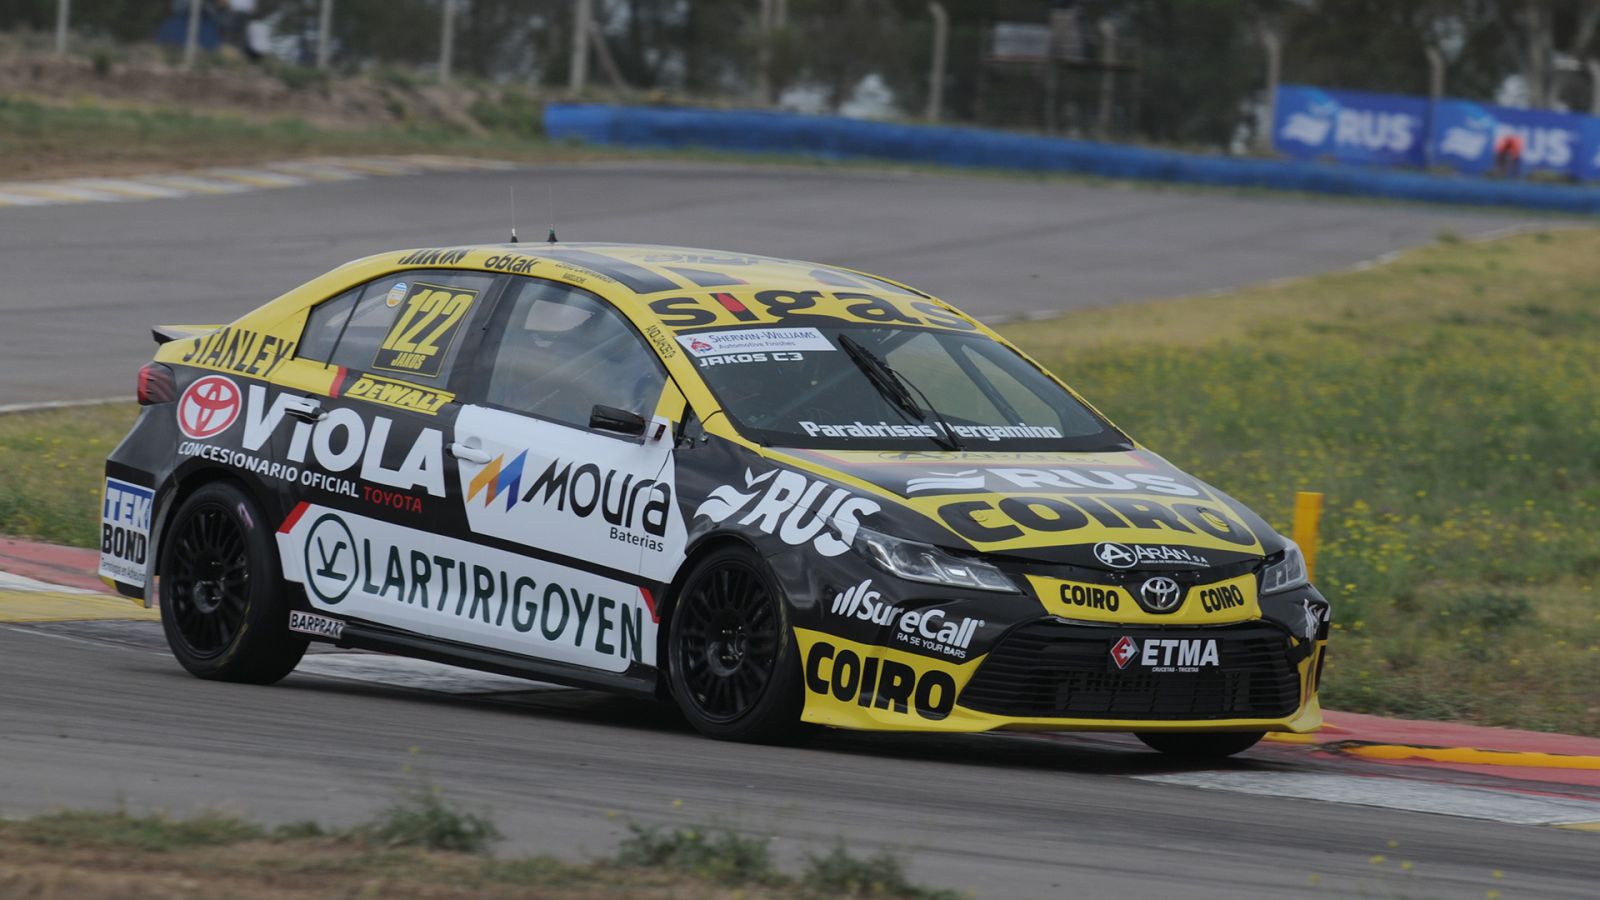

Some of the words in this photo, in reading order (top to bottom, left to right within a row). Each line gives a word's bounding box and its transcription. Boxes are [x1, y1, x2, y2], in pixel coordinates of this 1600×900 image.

[1335, 108, 1414, 152] RUS
[382, 289, 473, 356] 122
[182, 327, 294, 377] STANLEY
[391, 354, 427, 370] JAKOS
[700, 353, 768, 367] JAKOS
[773, 352, 804, 362] C3
[799, 421, 937, 438] Parabrisas
[178, 441, 298, 482] CONCESIONARIO
[301, 470, 359, 498] OFICIAL
[363, 485, 422, 513] TOYOTA
[985, 468, 1200, 497] RUS
[101, 487, 151, 530] TEK
[738, 469, 881, 557] RUS
[937, 496, 1257, 546] COIRO
[102, 522, 147, 565] BOND
[610, 526, 664, 553] Baterias
[363, 538, 643, 663] LARTIRIGOYEN
[1059, 583, 1120, 613] COIRO
[1200, 584, 1245, 614] COIRO
[1141, 639, 1220, 666] ETMA
[806, 641, 956, 721] COIRO
